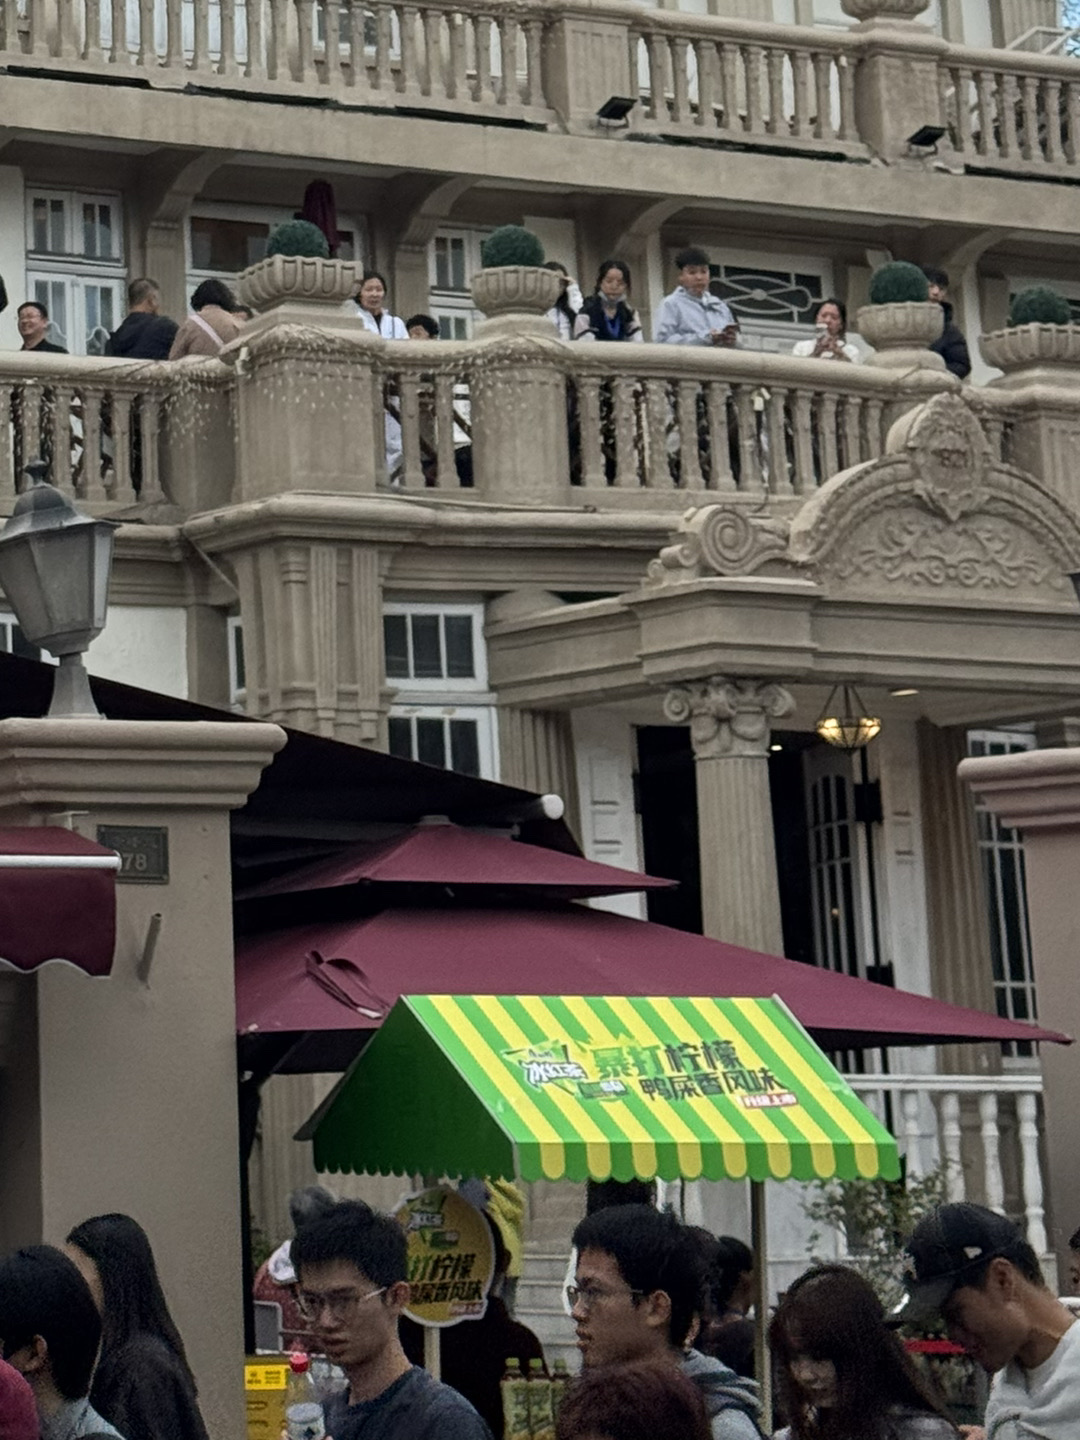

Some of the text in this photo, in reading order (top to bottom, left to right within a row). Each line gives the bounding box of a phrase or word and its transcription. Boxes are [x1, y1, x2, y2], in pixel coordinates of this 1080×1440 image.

[593, 1040, 745, 1079] 暴打柠檬
[639, 1068, 788, 1101] 鸭屎香风味
